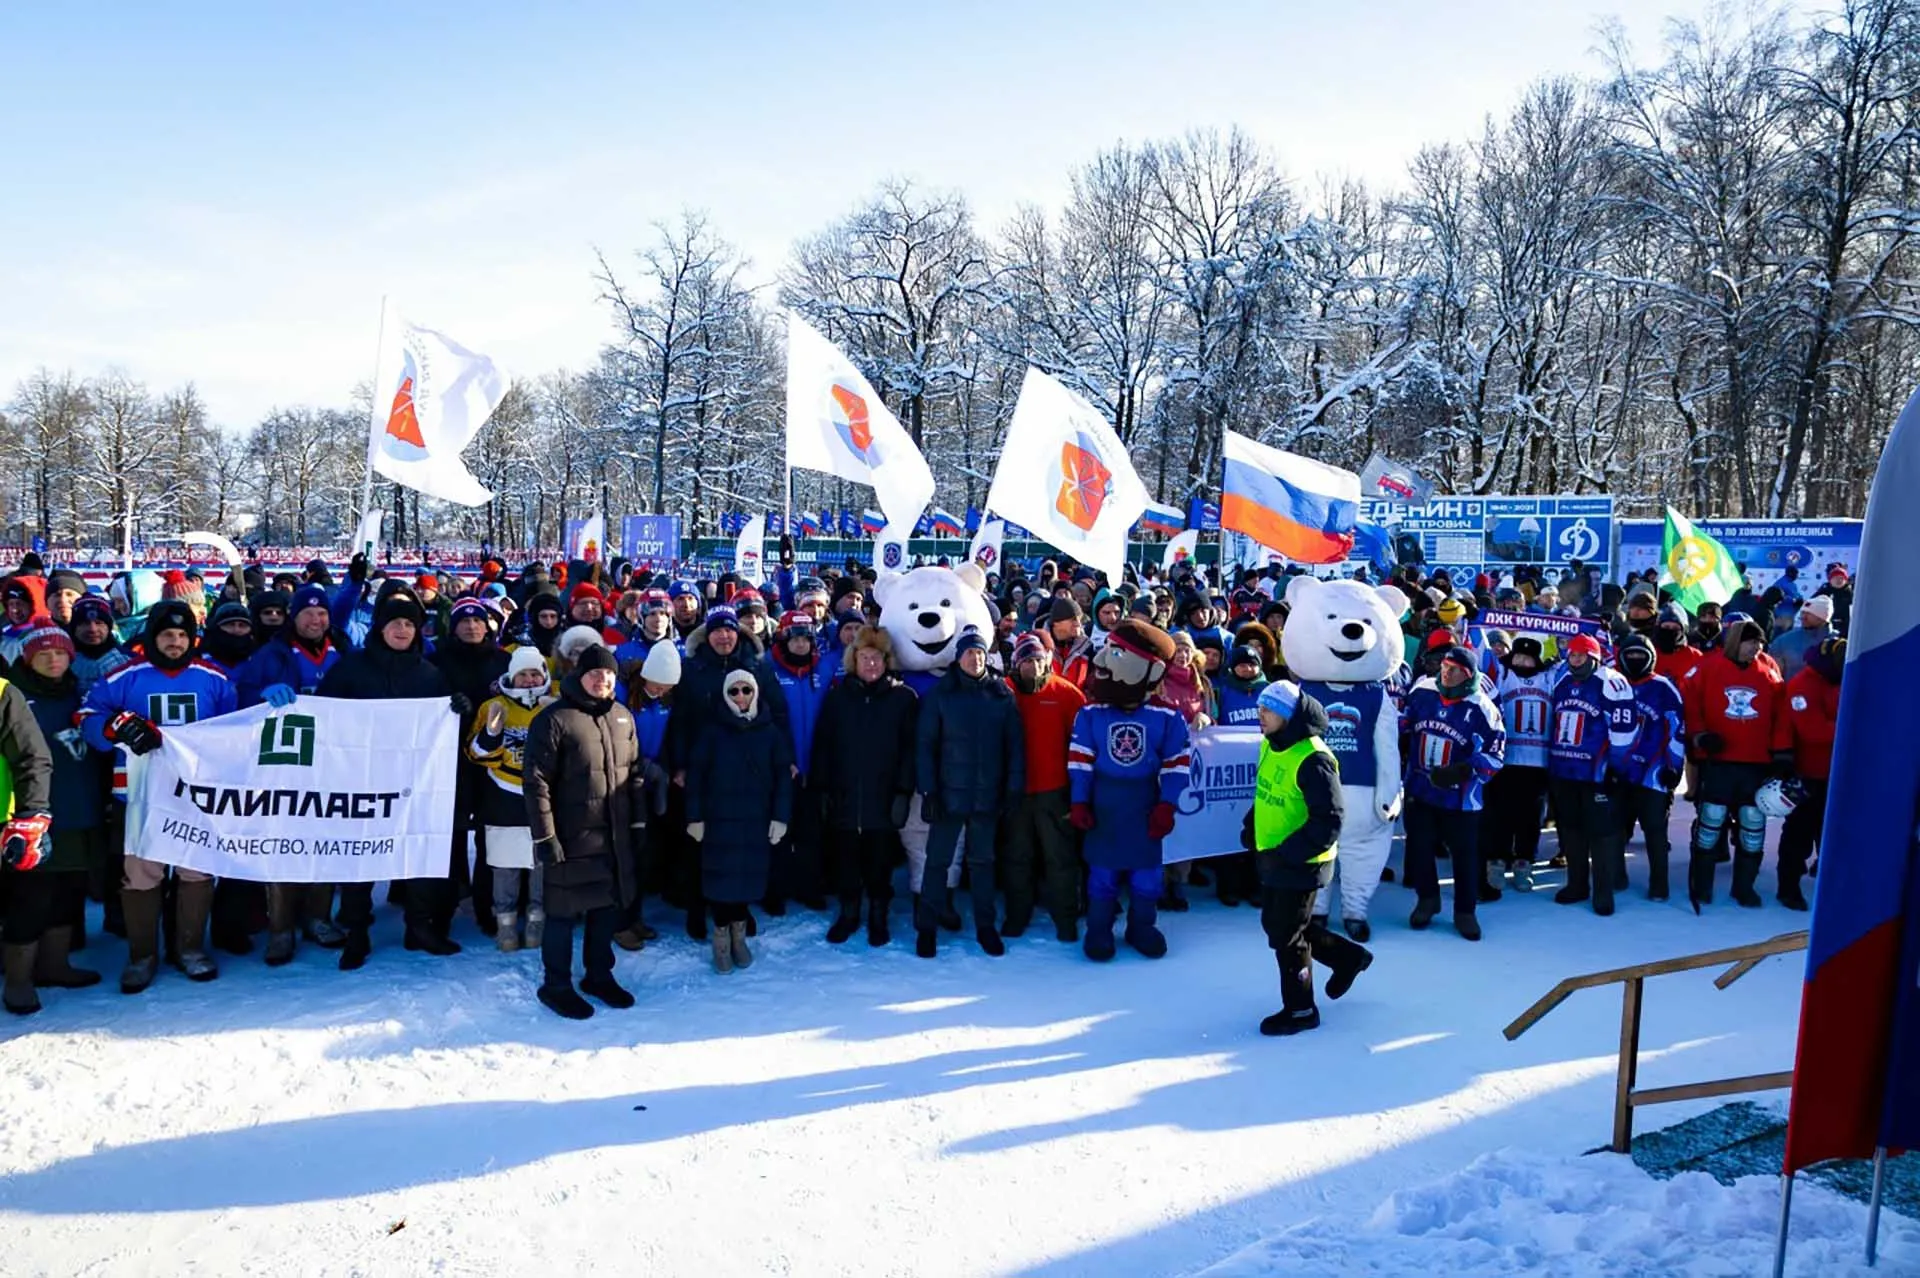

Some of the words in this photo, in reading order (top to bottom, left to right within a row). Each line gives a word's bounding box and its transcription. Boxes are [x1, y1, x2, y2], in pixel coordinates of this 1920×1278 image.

[1359, 502, 1463, 520] ЕДЕНИН
[1403, 520, 1471, 529] ПЕТРОВИЧ
[1725, 527, 1737, 536] ПО
[1739, 527, 1774, 537] ХОККЕЮ
[1777, 527, 1783, 536] В
[1785, 527, 1833, 537] ВАЛЕНКАХ
[1485, 612, 1513, 625] ЛХК
[1515, 616, 1579, 634] КУРКИНО
[1228, 707, 1259, 723] ГАЗОВ
[1612, 708, 1632, 724] 89
[1428, 720, 1468, 746] КУРКИНО
[1330, 744, 1358, 752] ОССИЯ
[1206, 763, 1256, 787] ГАЗПР
[161, 818, 212, 849] ИДЕЯ.
[216, 835, 308, 855] КАЧЕСТВО.
[314, 838, 394, 856] МАТЕРИЯ
